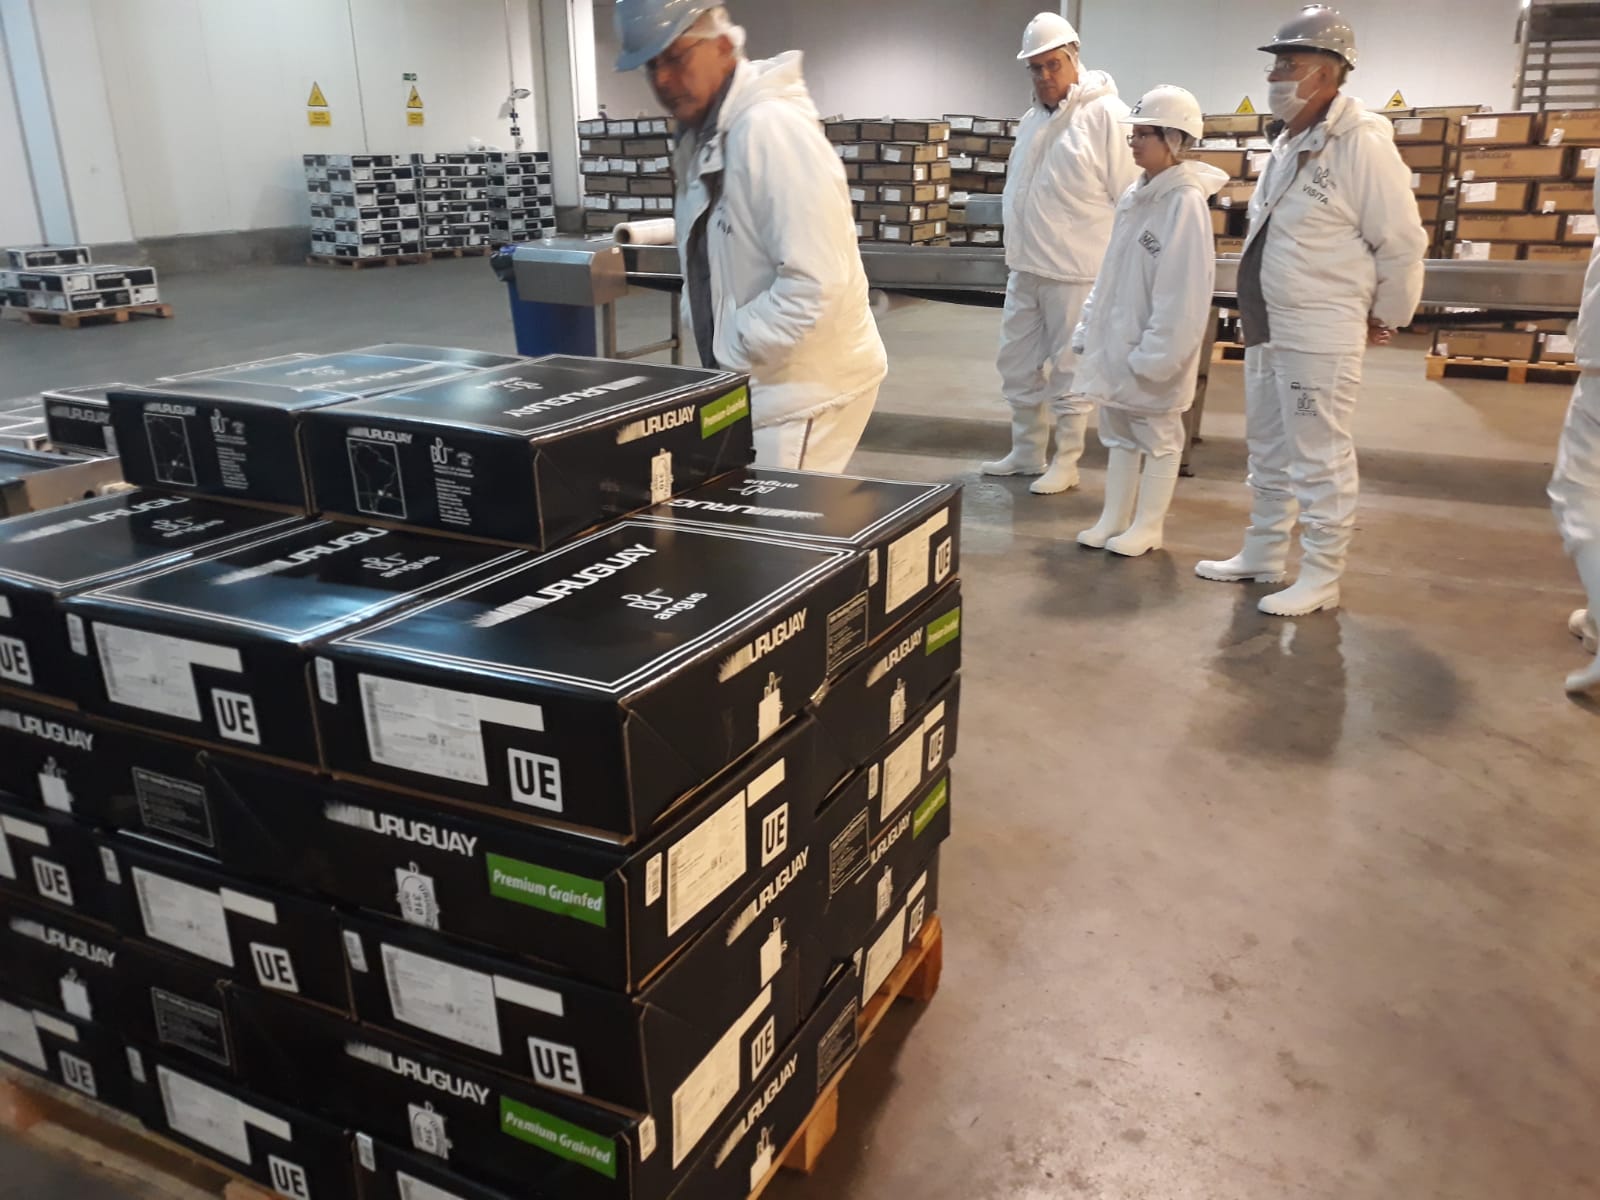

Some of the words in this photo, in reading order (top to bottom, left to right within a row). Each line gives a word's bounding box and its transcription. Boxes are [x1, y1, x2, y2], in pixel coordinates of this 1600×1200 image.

[503, 387, 609, 417] URUGUAY
[641, 405, 696, 436] URUGUAY
[367, 427, 413, 444] URUGUAY
[74, 496, 190, 527] URUGU
[668, 498, 757, 515] URUG
[278, 527, 389, 567] URUGU
[380, 556, 440, 577] angus
[938, 543, 949, 575] UE
[537, 543, 656, 604] URUGUAY
[653, 592, 708, 620] angus
[750, 608, 808, 663] URUGUAY
[884, 626, 923, 672] URUGUAY
[0, 642, 28, 676] UE
[18, 713, 94, 751] URUGUAY
[217, 696, 255, 736] UE
[514, 756, 557, 802] UE
[370, 812, 477, 856] URUGUAY
[765, 811, 785, 856] UE
[872, 811, 911, 865] URUGUAY
[38, 867, 67, 897] UE
[493, 868, 546, 896] Premium
[548, 884, 604, 912] Grainfed
[754, 846, 809, 916] URUGUAY
[41, 928, 116, 968] URUGUAY
[257, 956, 295, 985] UE
[534, 1045, 578, 1086] UE
[753, 1022, 774, 1070] UE
[63, 1060, 94, 1089] UE
[388, 1054, 490, 1104] URUGUAY
[742, 1053, 798, 1131] URUGUAY
[505, 1111, 558, 1143] Premium
[558, 1133, 612, 1165] Grainfed
[273, 1165, 305, 1198] UE
